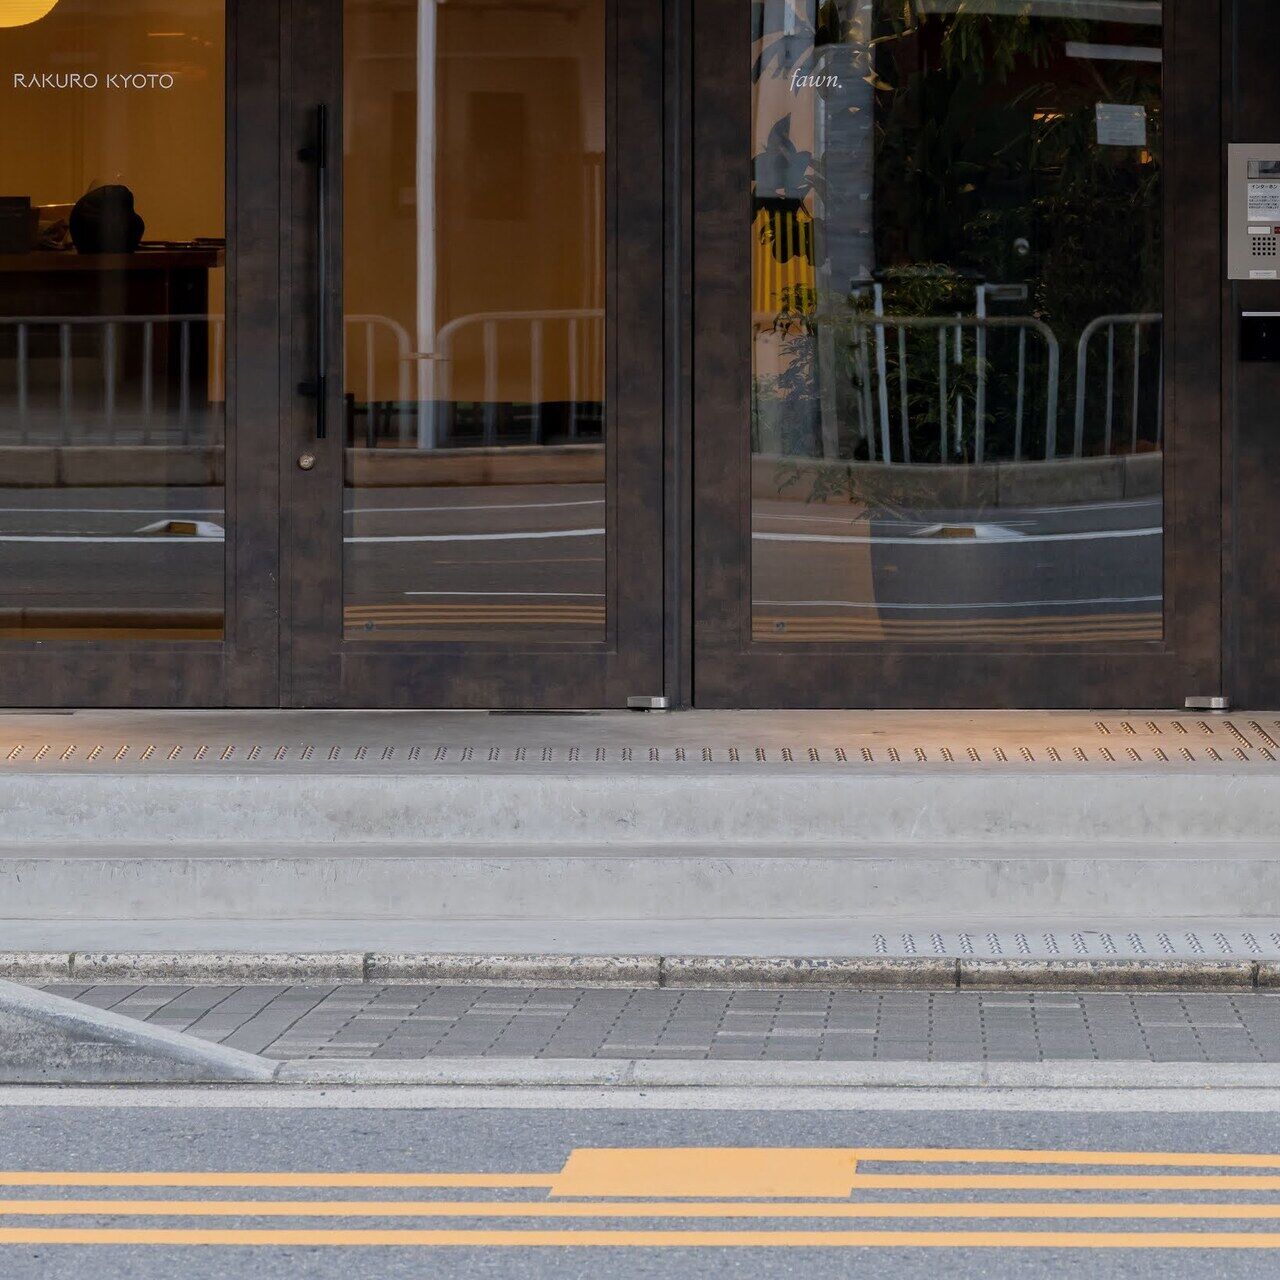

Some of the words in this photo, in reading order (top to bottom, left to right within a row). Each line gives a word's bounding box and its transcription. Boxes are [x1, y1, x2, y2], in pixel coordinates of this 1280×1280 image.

[14, 73, 98, 89] RAKURO
[106, 73, 174, 89] KYOTO
[789, 68, 843, 92] fawn.
